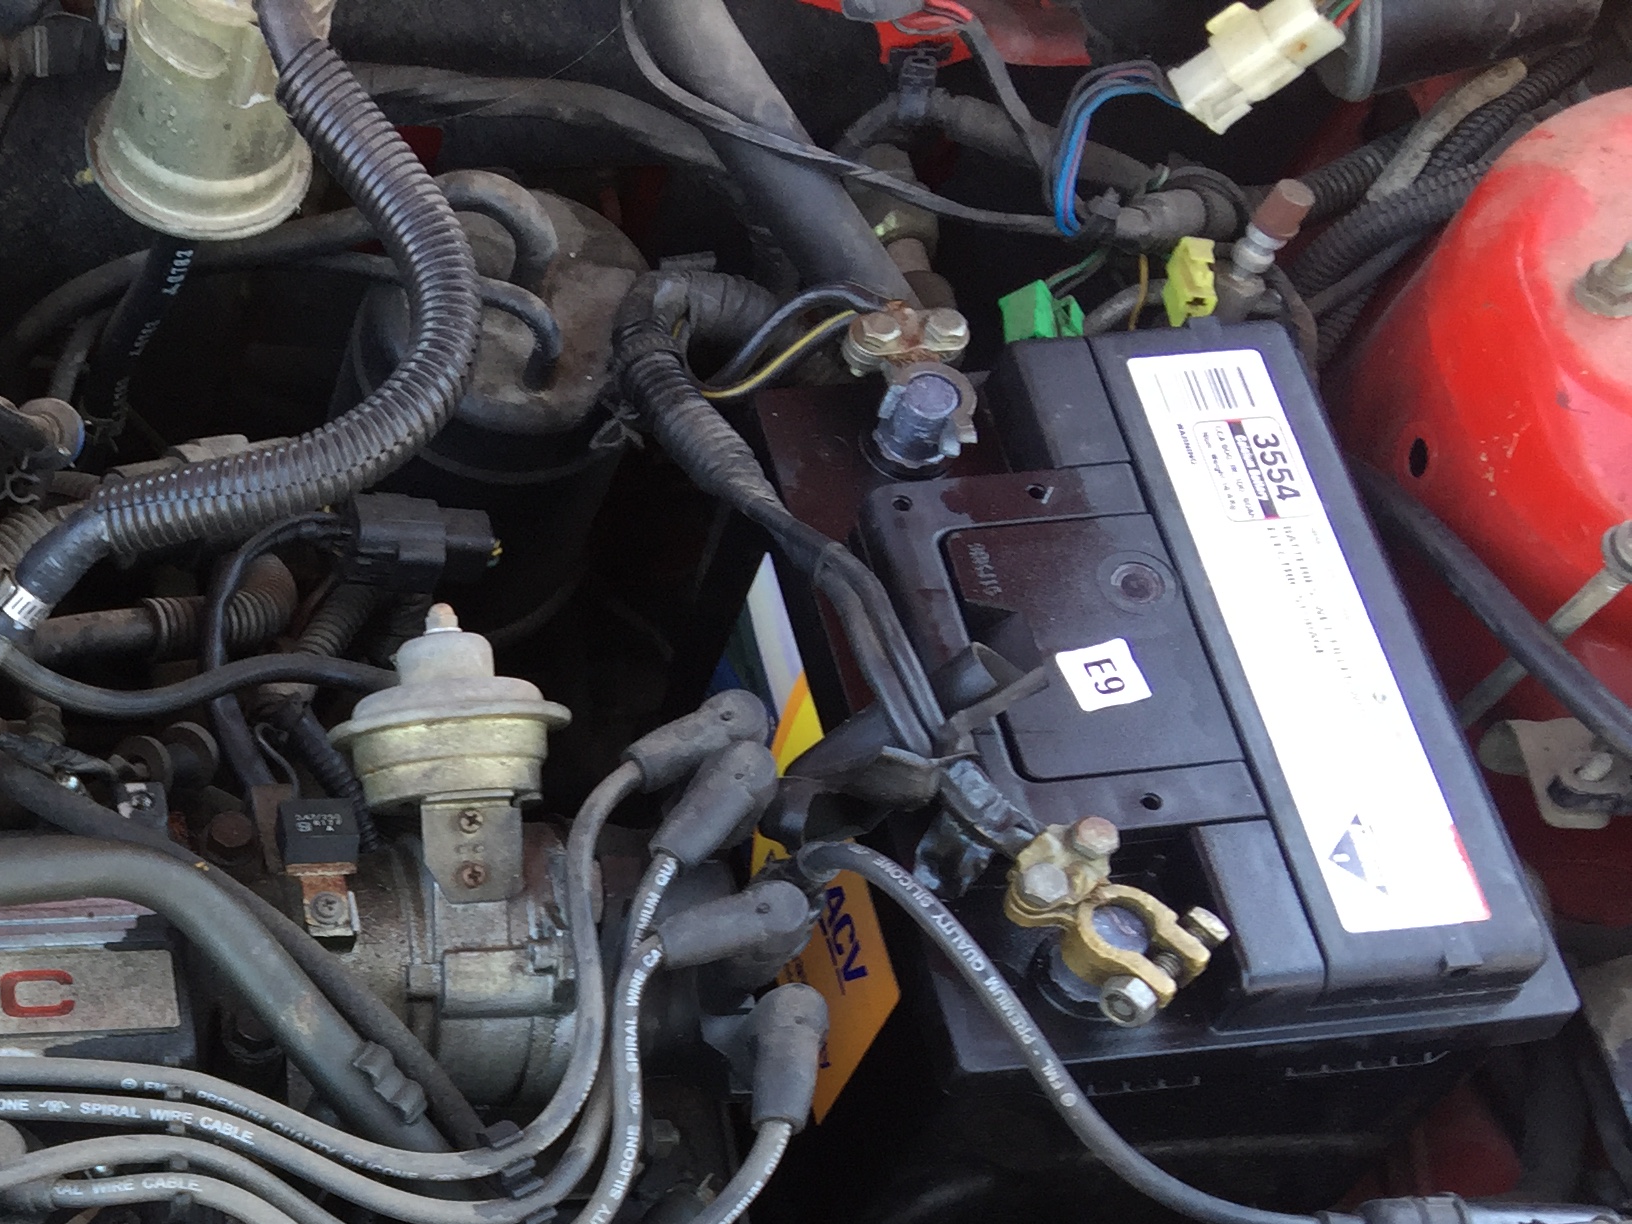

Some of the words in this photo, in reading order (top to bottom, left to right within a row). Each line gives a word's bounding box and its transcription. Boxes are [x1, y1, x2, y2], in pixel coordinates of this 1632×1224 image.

[1253, 433, 1301, 501] 3554
[1083, 658, 1125, 695] E9
[931, 913, 986, 973] QUALITY
[625, 968, 648, 1007] WIRE
[624, 1015, 639, 1073] SPIRAL
[79, 1101, 142, 1119] SPIRAL
[149, 1108, 194, 1125] WIRE
[609, 1124, 641, 1201] SILICONE
